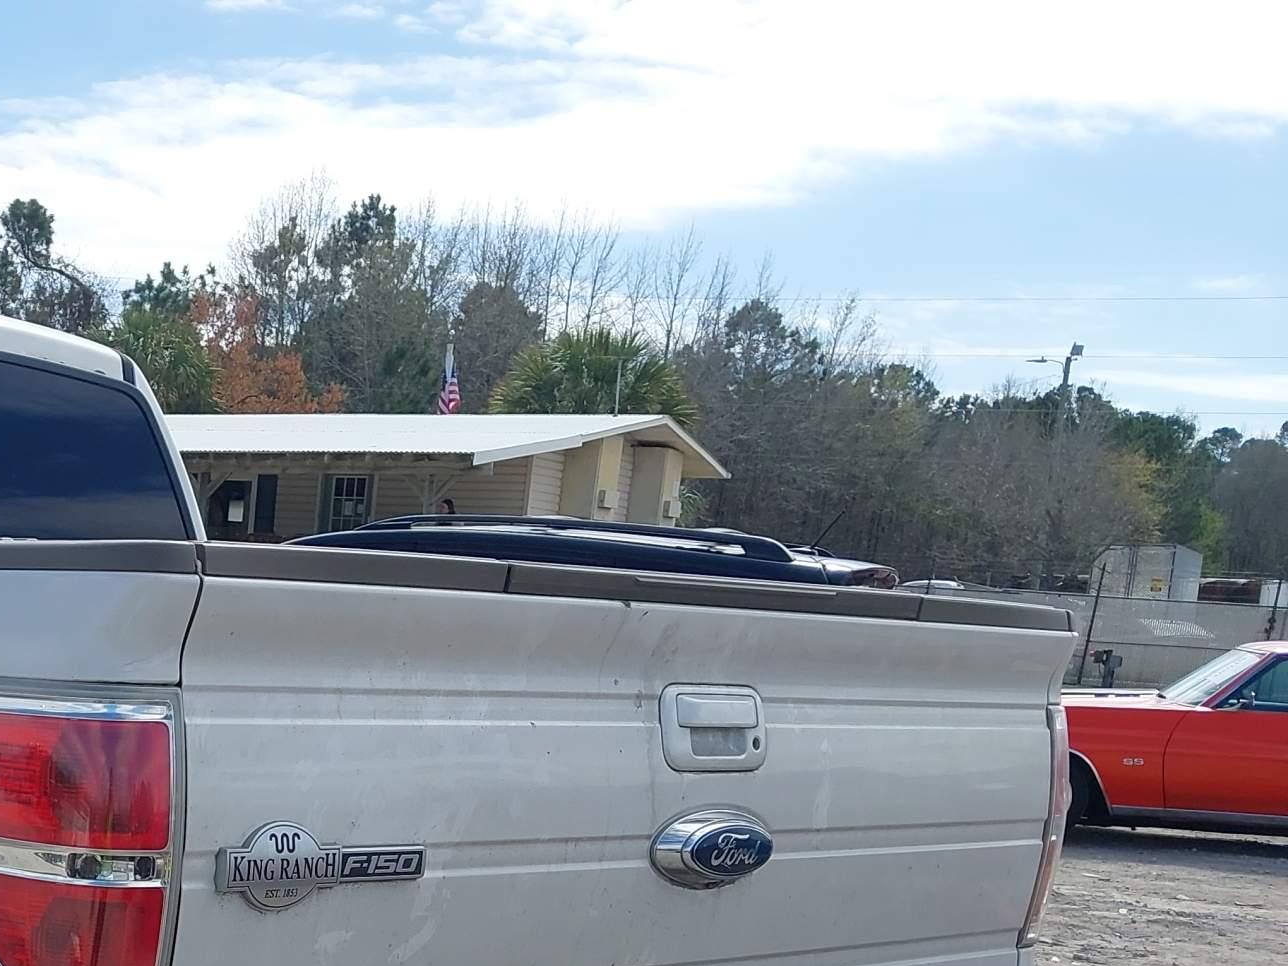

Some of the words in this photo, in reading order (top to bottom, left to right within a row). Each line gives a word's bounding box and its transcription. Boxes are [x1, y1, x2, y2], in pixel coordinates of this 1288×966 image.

[1122, 757, 1145, 766] SS
[711, 833, 761, 868] Ford
[232, 855, 275, 882] KING
[279, 853, 337, 880] RANCH
[264, 889, 281, 899] EST.
[282, 888, 298, 898] 1853
